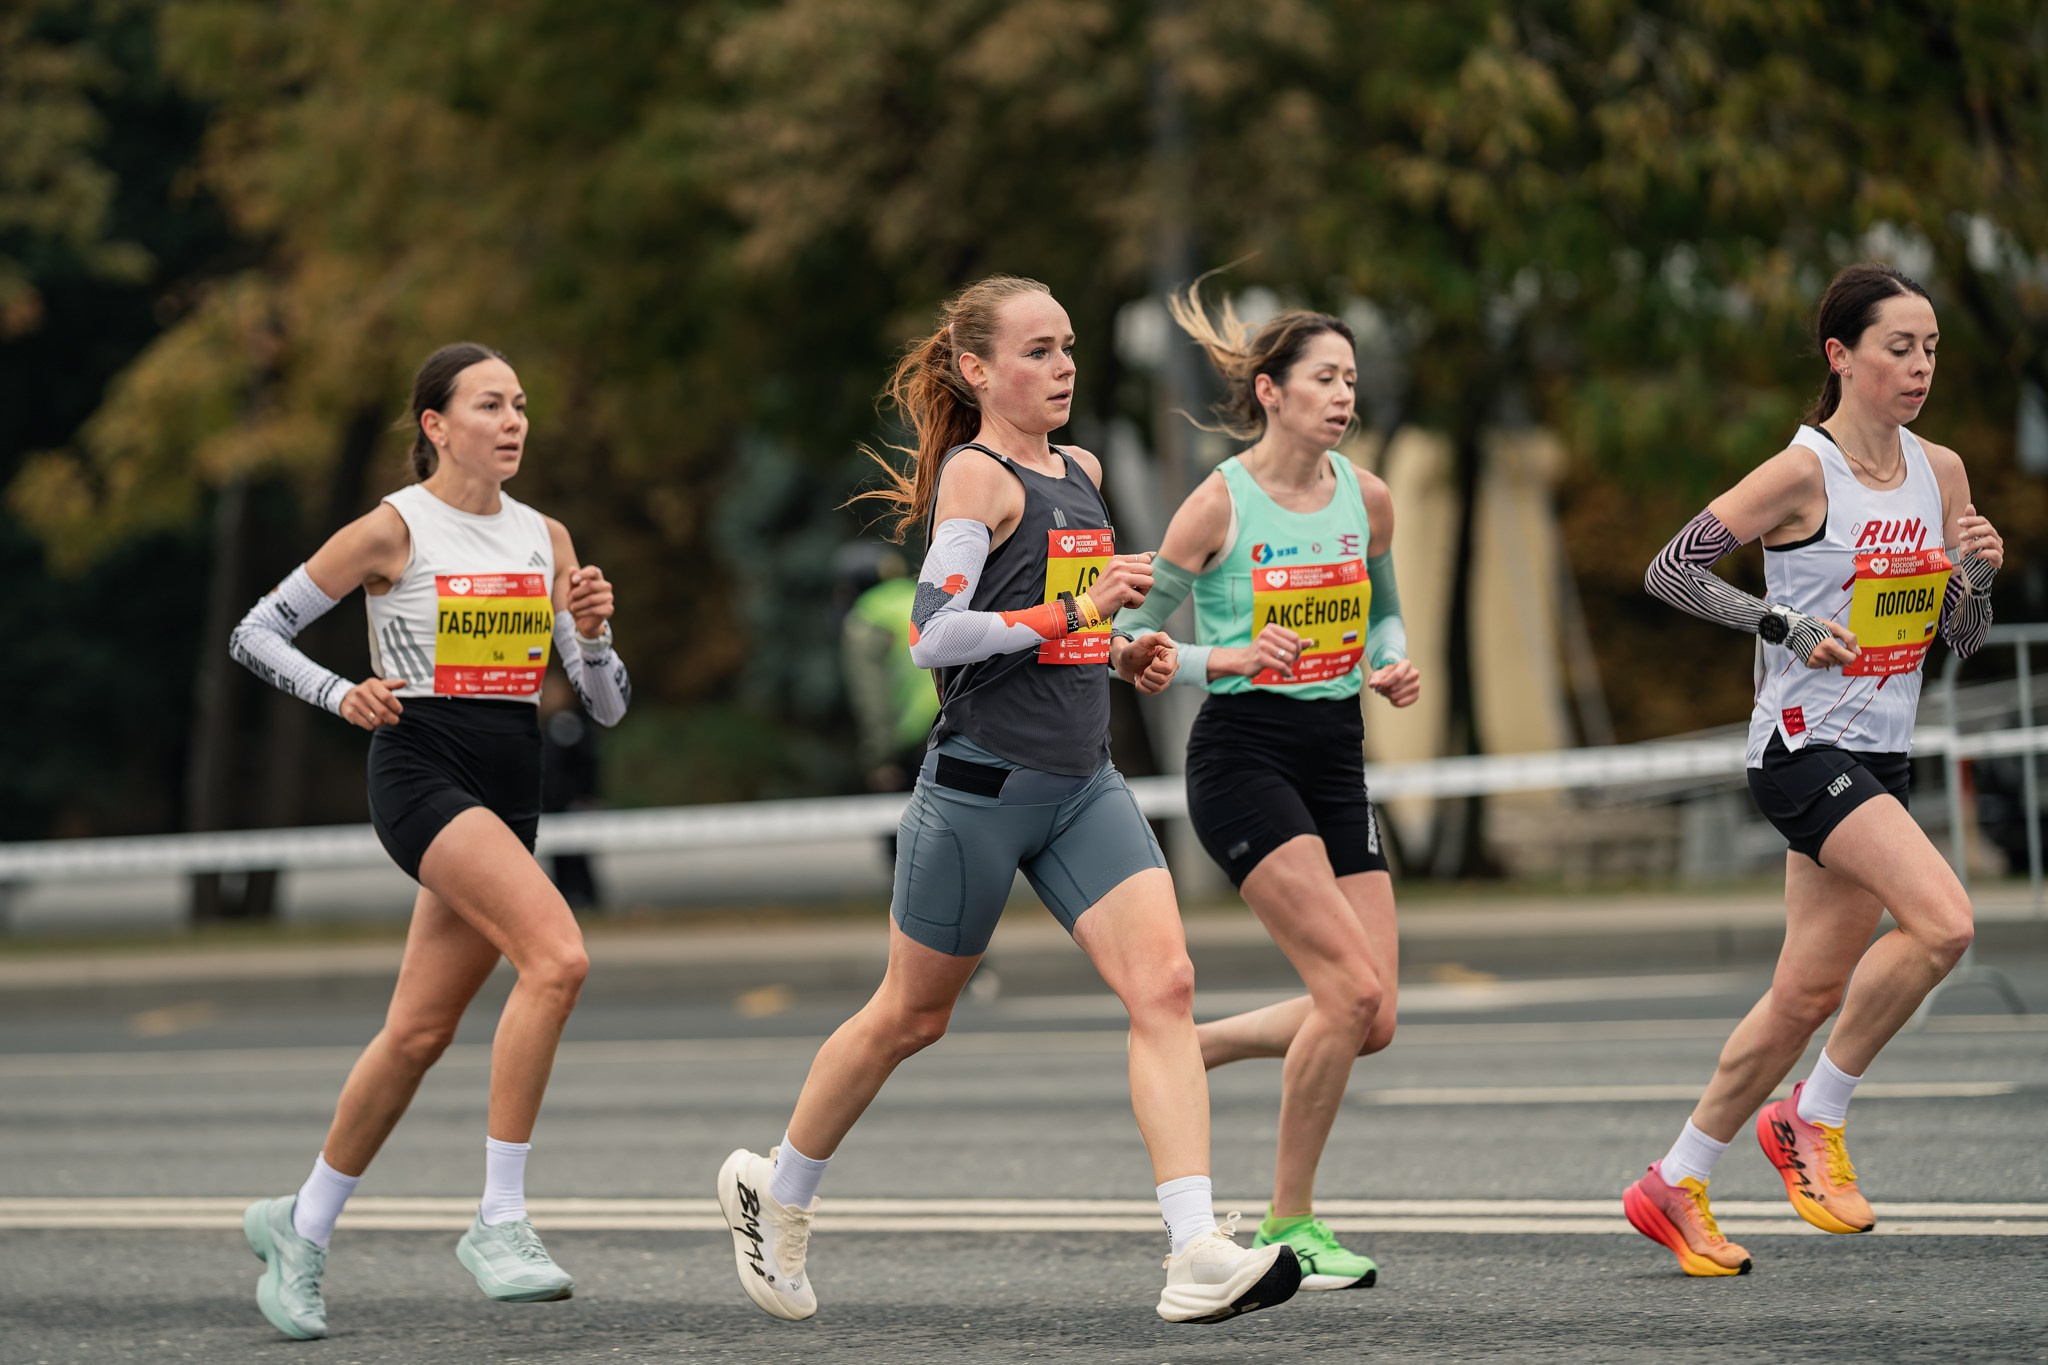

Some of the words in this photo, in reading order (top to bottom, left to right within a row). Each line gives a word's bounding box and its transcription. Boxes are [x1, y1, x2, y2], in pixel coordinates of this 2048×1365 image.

[1264, 596, 1361, 628] АКСЁНОВА
[1875, 587, 1935, 618] ПОПОВА
[438, 611, 551, 639] ГАБДУЛЛИНА
[1897, 629, 1906, 640] 51
